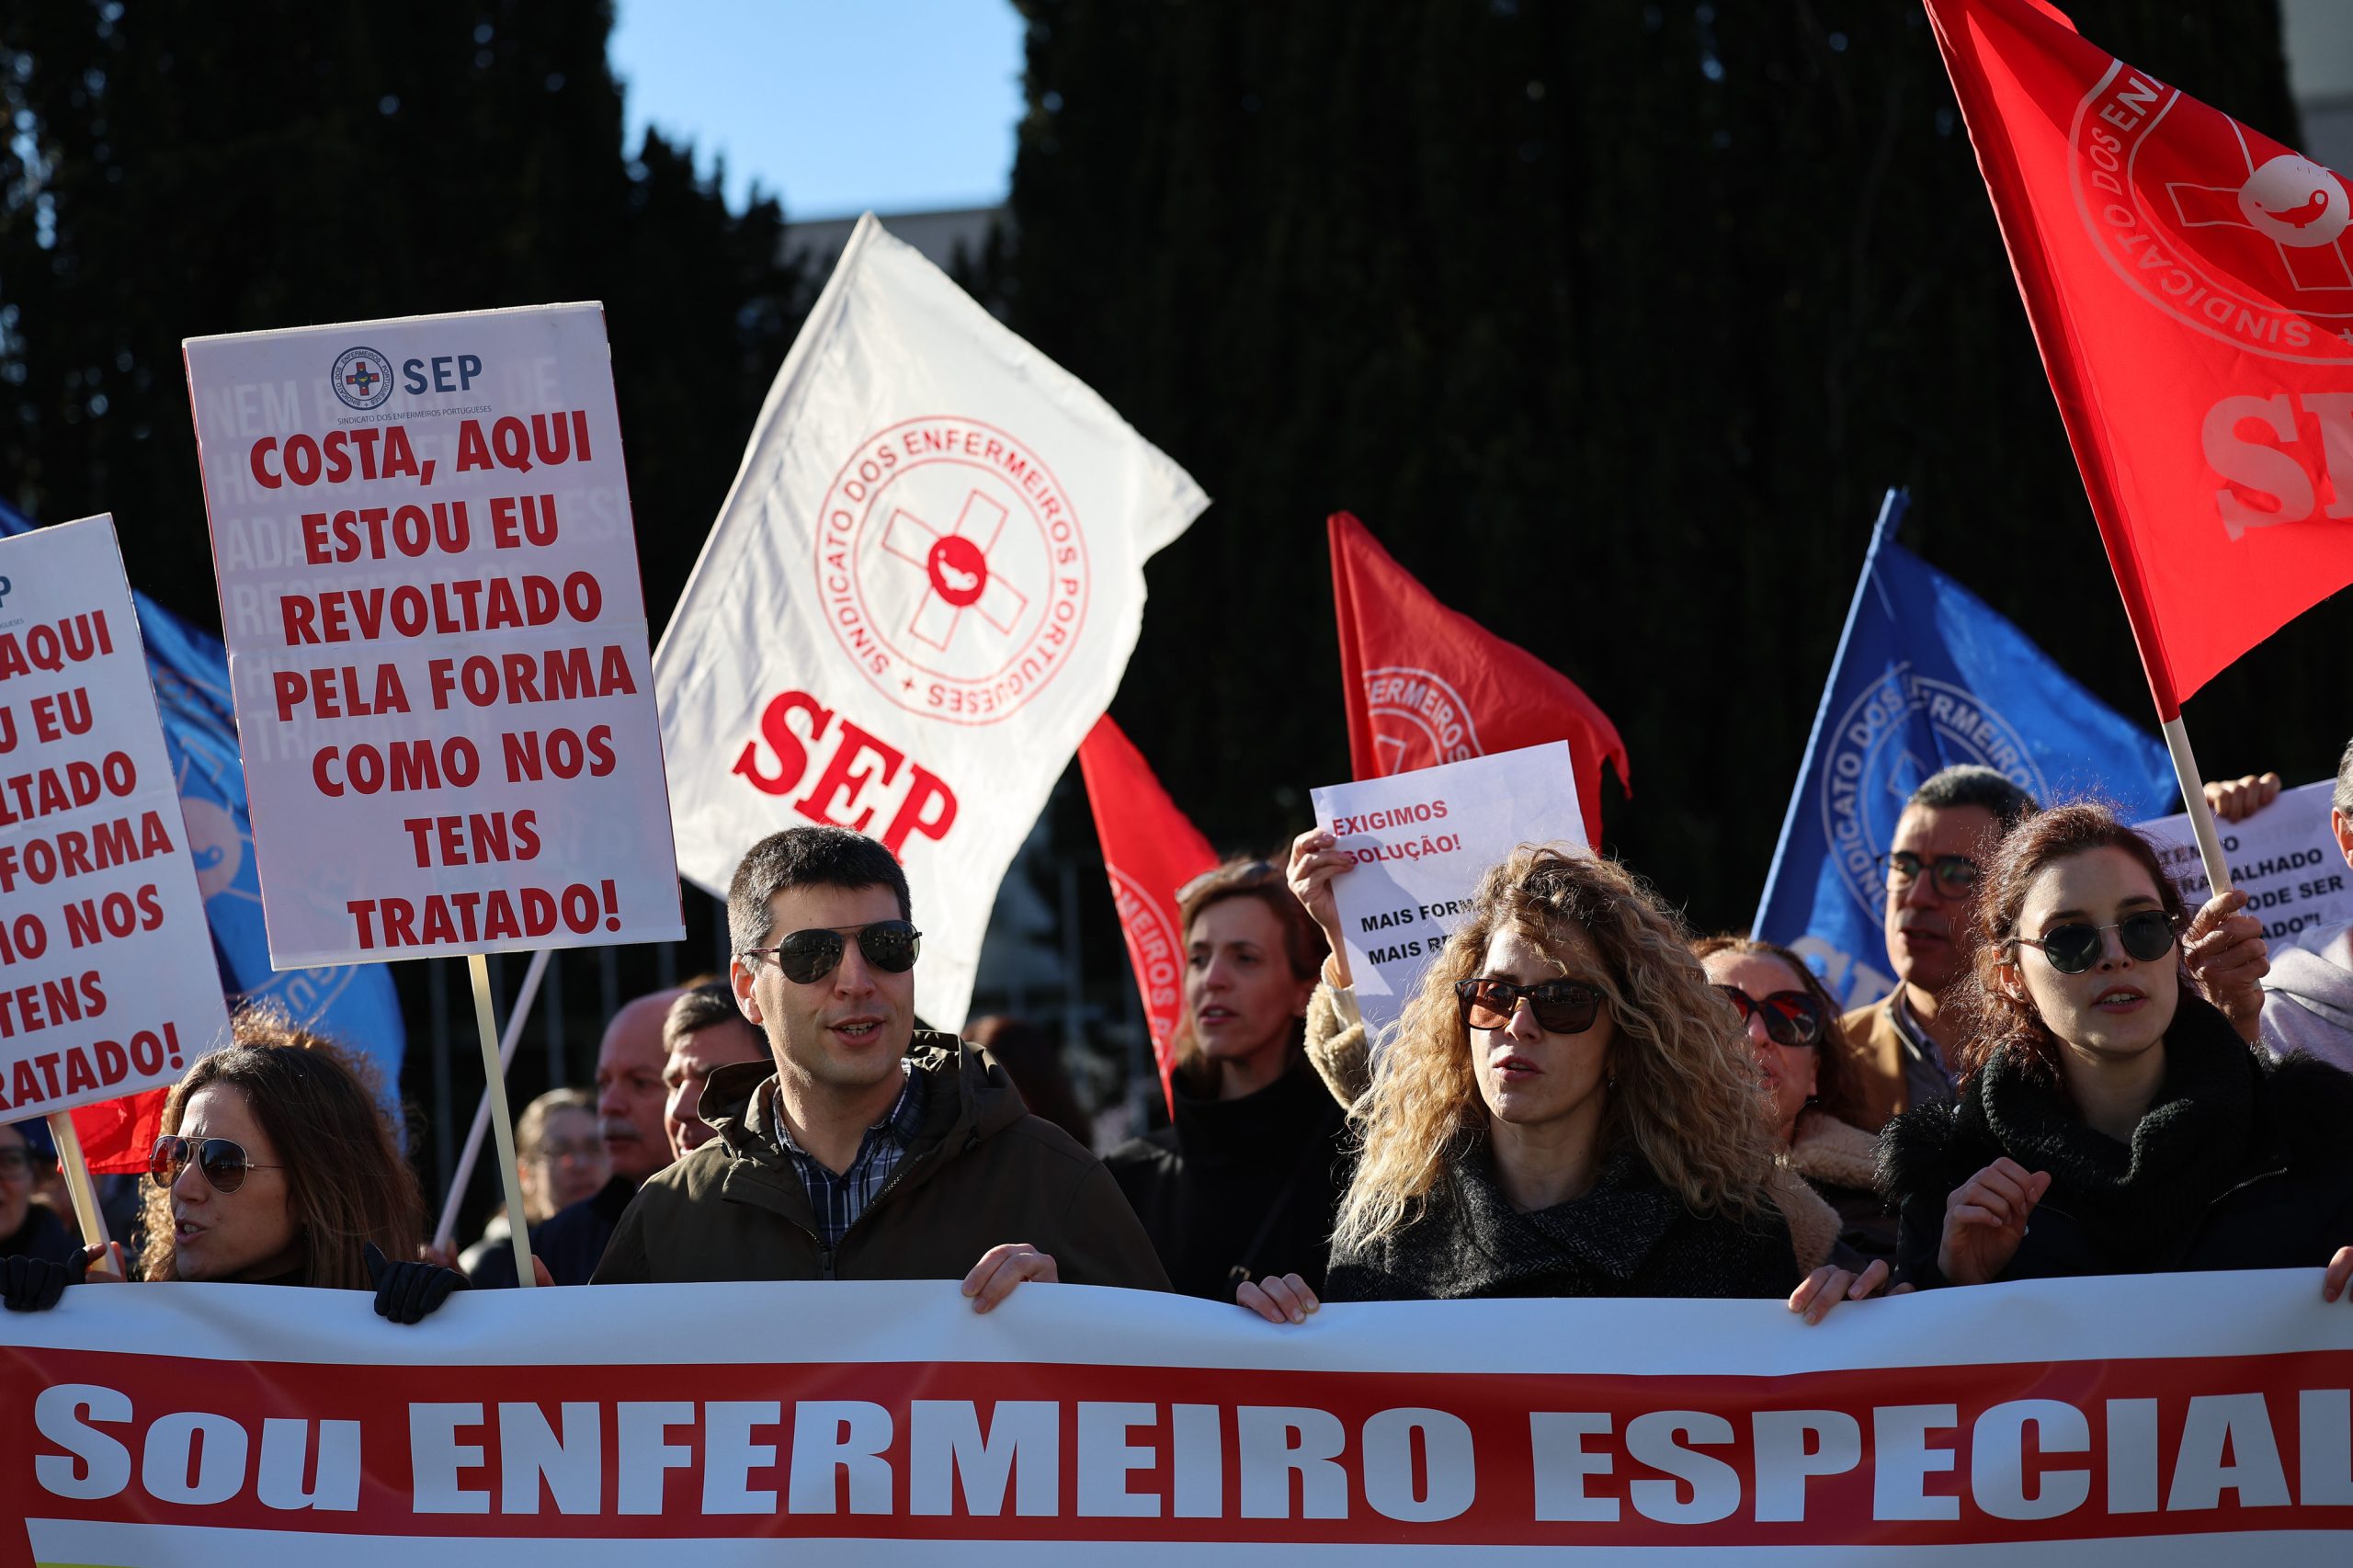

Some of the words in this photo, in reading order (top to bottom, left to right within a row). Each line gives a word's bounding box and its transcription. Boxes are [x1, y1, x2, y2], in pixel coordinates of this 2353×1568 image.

[2089, 127, 2122, 196] DOS
[2103, 204, 2312, 347] SINDICATO
[403, 354, 483, 395] SEP
[250, 426, 437, 489] COSTA,
[456, 410, 593, 473] AQUI
[337, 415, 375, 426] SINDICATO
[377, 413, 392, 422] DOS
[393, 409, 441, 420] ENFERMEIROS
[442, 405, 493, 416] PORTUGUESES
[843, 444, 899, 504] DOS
[902, 428, 1080, 566] ENFERMEIROS
[301, 501, 471, 565] ESTOU
[489, 494, 559, 550] EU
[280, 571, 603, 646] REVOLTADO
[826, 509, 890, 677] SINDICATO
[0, 609, 113, 681] AQUI
[926, 576, 1081, 715] PORTUGUESES
[30, 687, 93, 744] EU
[274, 664, 411, 722] PELA
[429, 645, 637, 710] FORMA
[1847, 687, 1904, 750] DOS
[313, 736, 480, 798] COMO
[502, 725, 616, 784] NOS
[732, 690, 959, 867] SEP
[0, 810, 175, 893] FORMA
[404, 810, 541, 868] TENS
[1332, 800, 1449, 837] EXIGIMOS
[63, 883, 165, 949] NOS
[347, 879, 621, 949] TRATADO!
[1360, 908, 1415, 933] MAIS
[2299, 875, 2346, 899] SER
[1368, 939, 1423, 965] MAIS
[34, 1383, 362, 1512] Sou
[407, 1399, 1476, 1524] ENFERMEIRO
[1528, 1388, 2353, 1525] ESPECIAL
